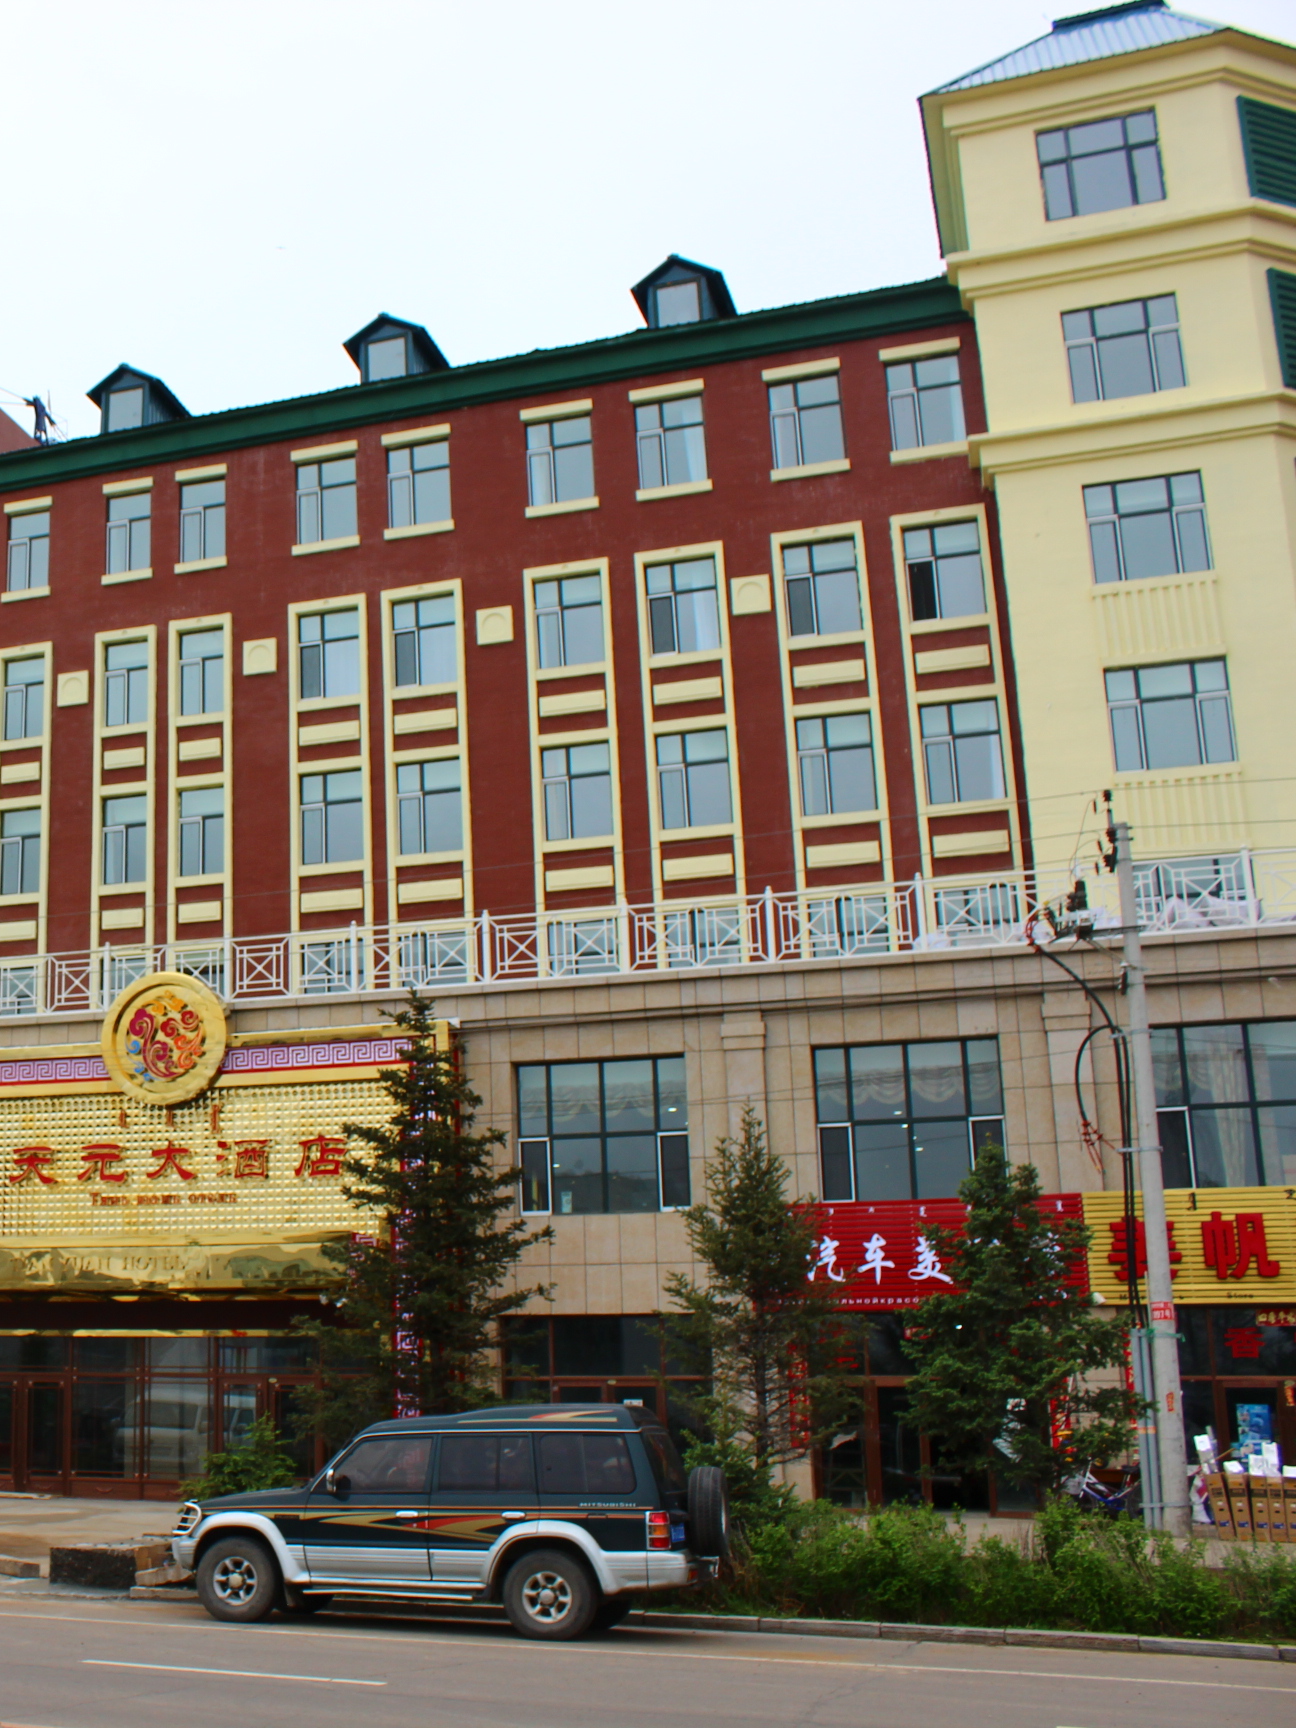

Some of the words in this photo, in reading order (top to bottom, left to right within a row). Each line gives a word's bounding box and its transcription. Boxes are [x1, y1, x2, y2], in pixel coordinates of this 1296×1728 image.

[9, 1134, 347, 1184] 天元大酒店
[122, 1255, 187, 1271] HOTEL
